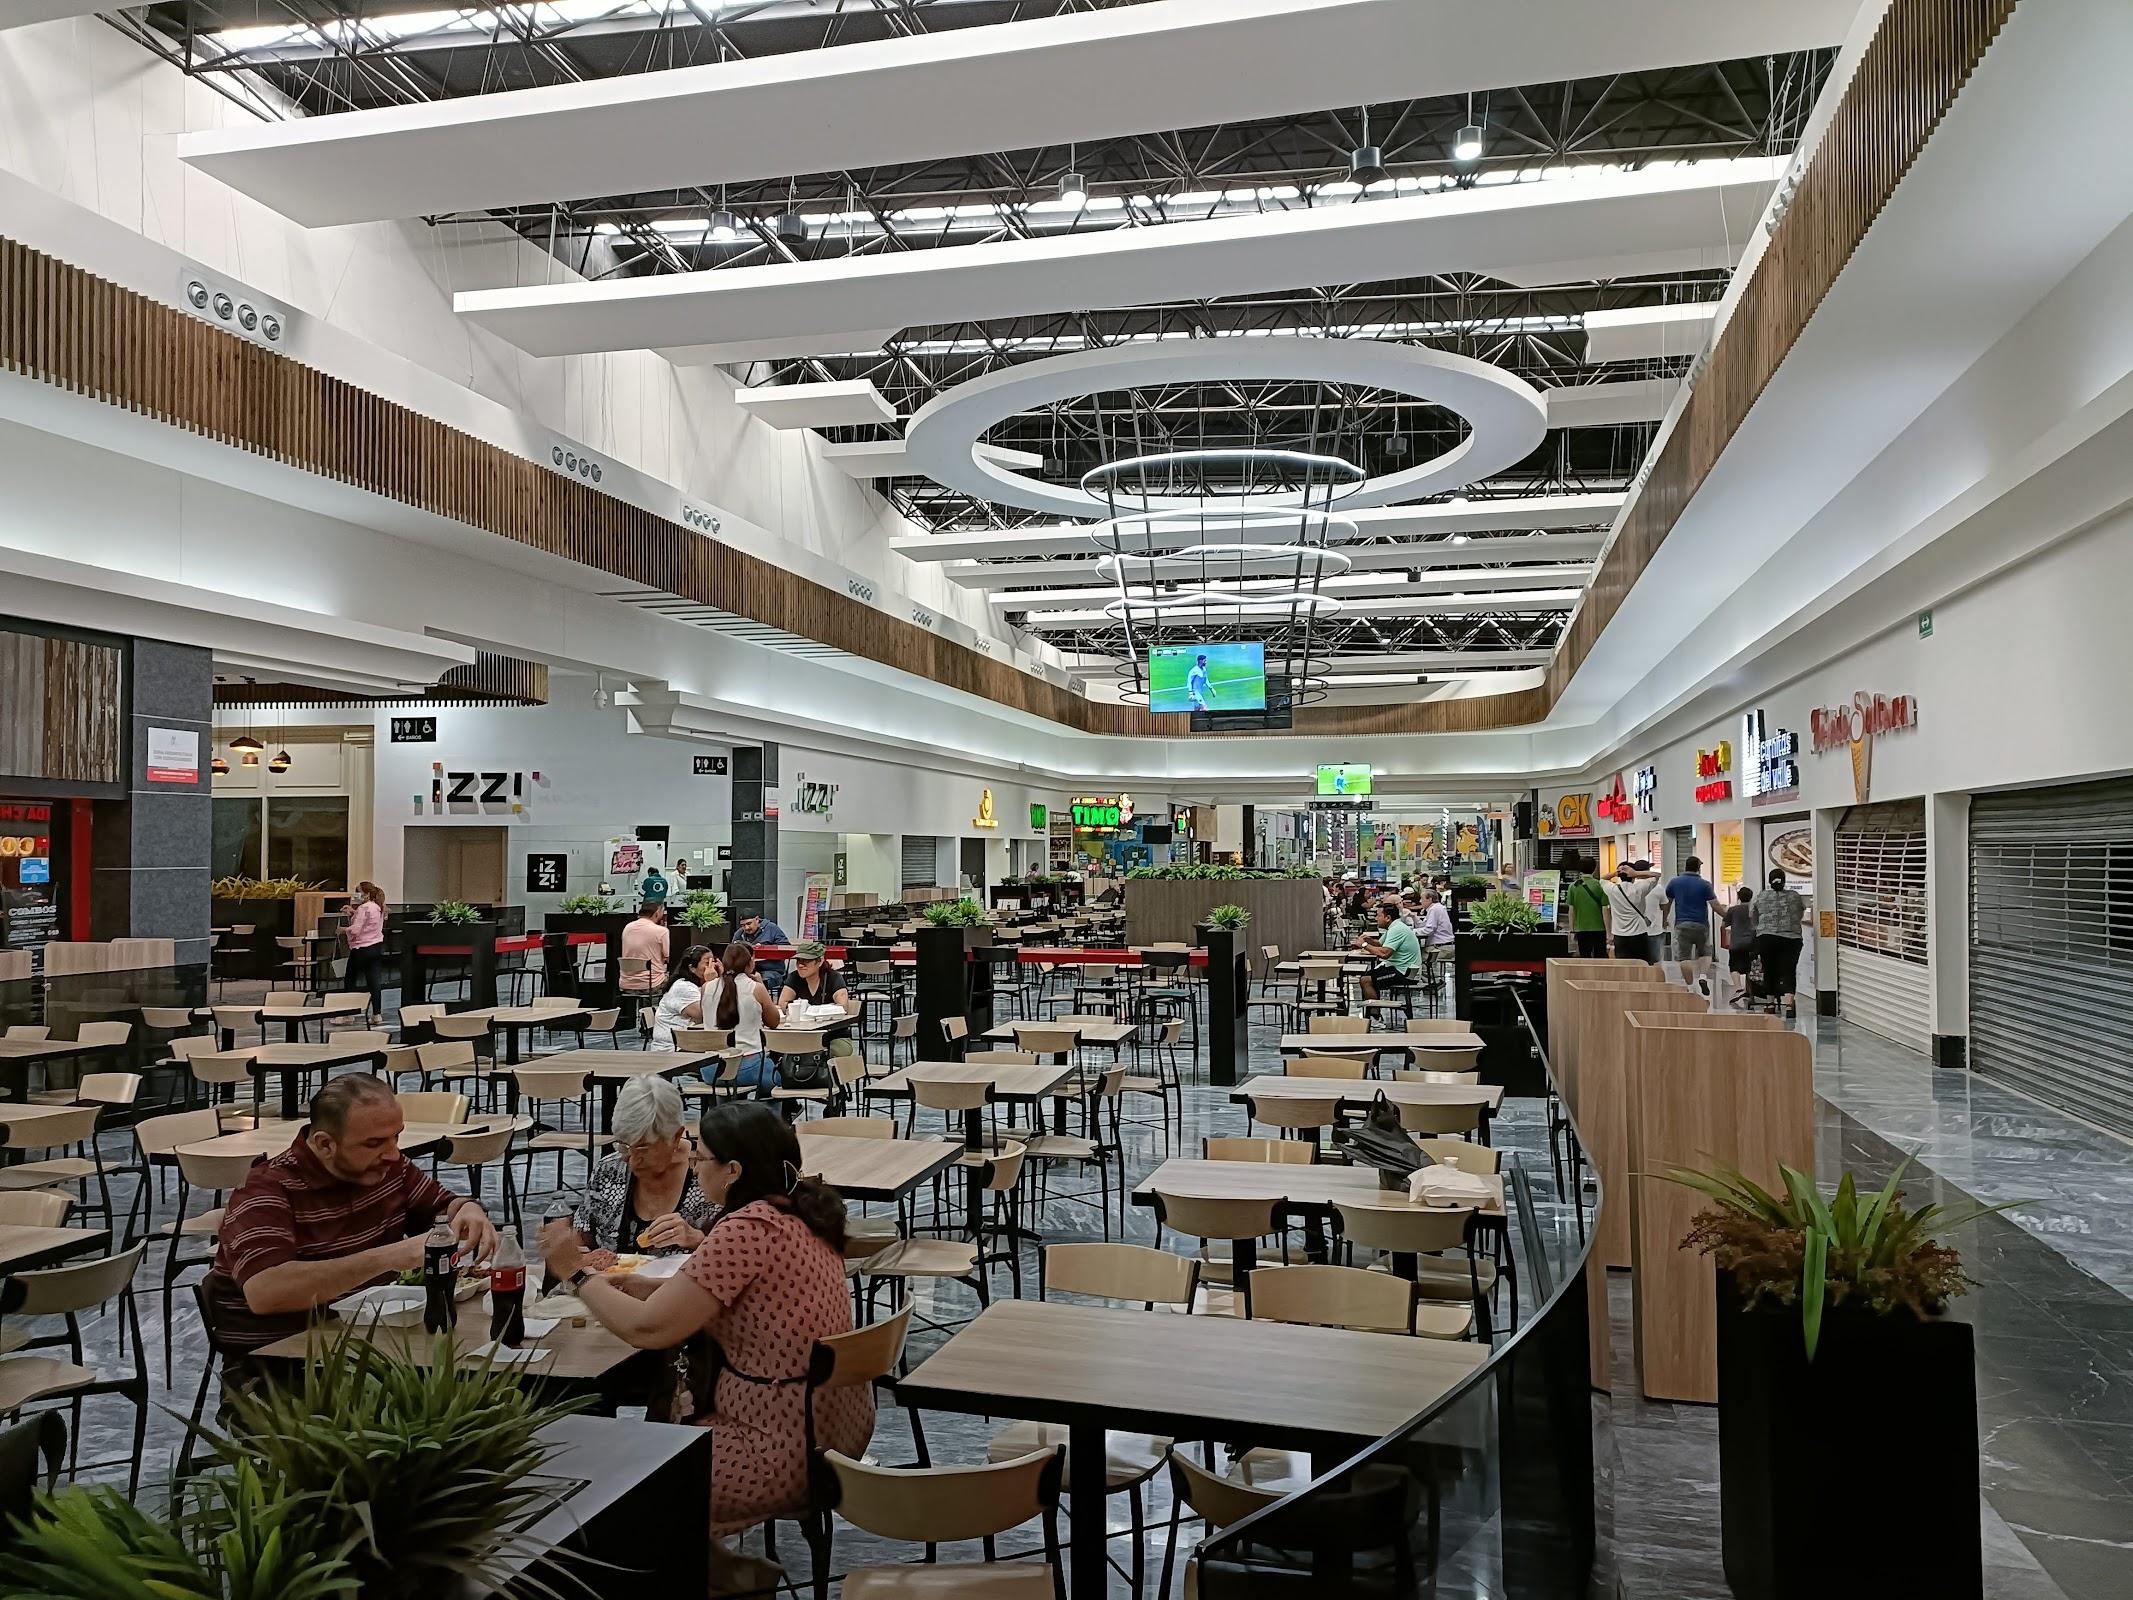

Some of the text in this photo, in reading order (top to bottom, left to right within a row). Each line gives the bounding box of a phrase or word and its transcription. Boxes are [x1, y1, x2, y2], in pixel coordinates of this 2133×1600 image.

[1072, 805, 1120, 826] TIMO
[1557, 793, 1591, 828] CK
[8, 904, 57, 917] COMBOS
